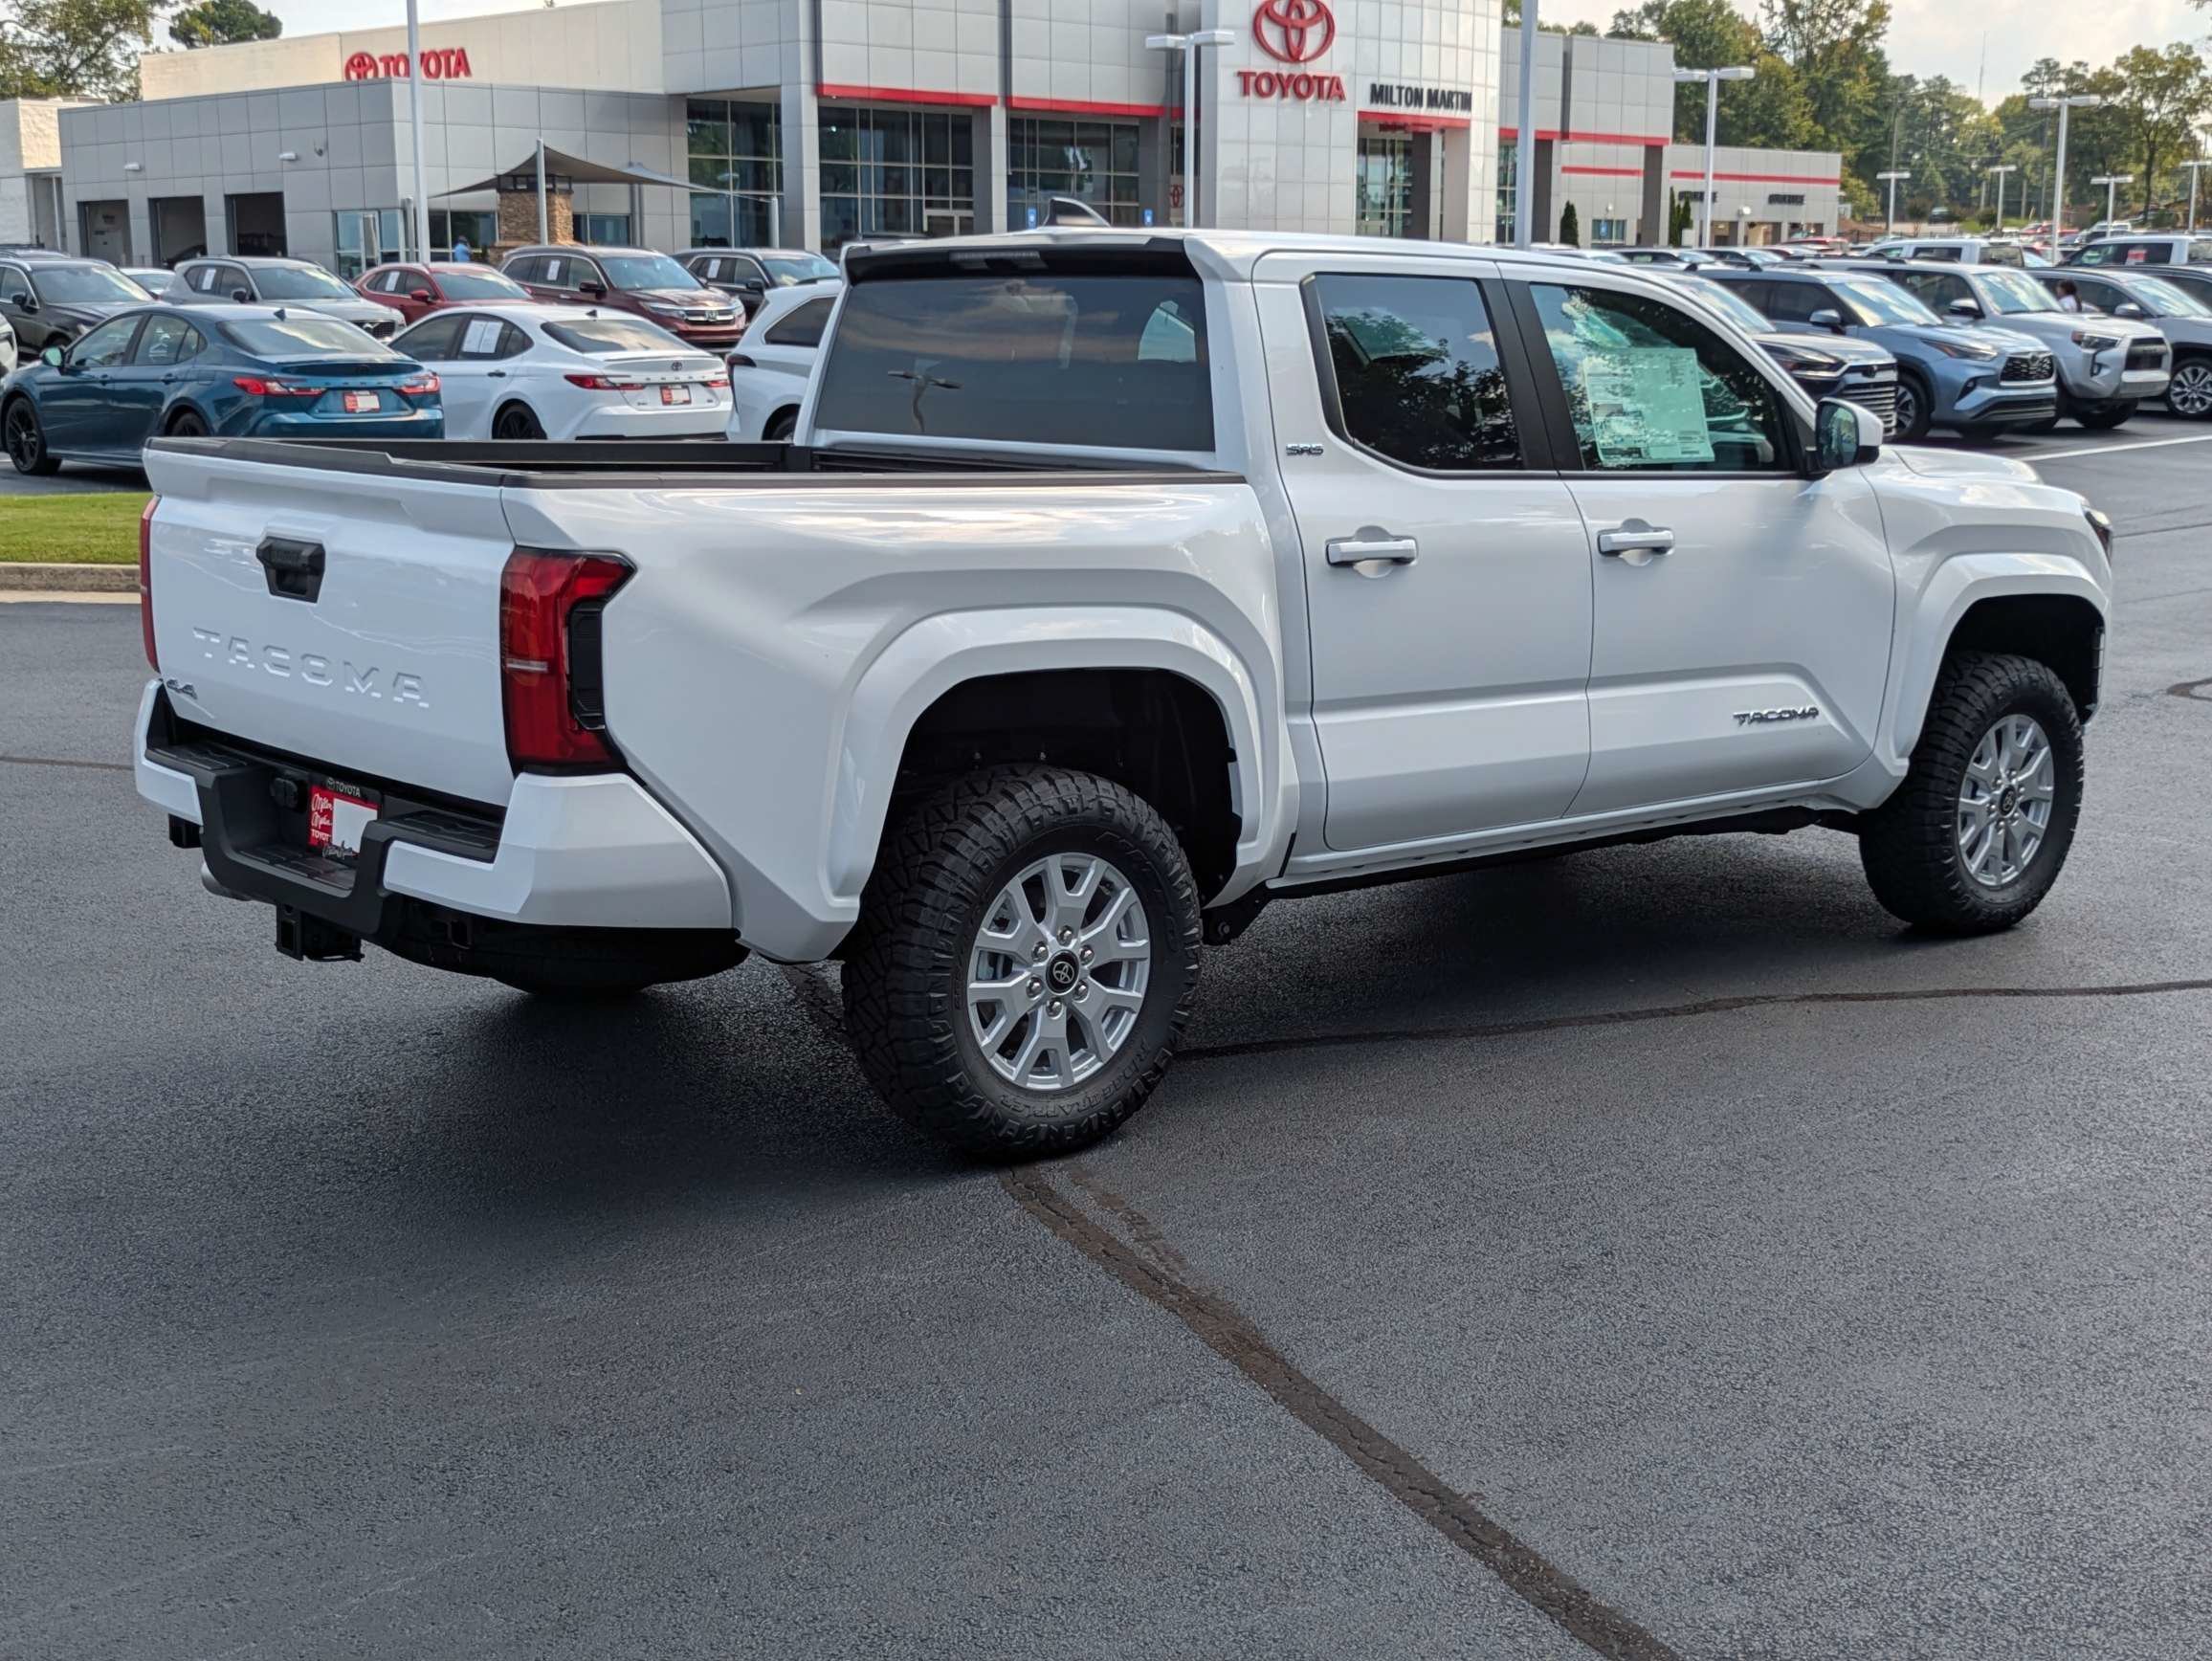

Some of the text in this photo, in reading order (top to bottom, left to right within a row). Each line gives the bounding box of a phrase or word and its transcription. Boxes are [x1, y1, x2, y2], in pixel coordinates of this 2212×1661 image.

[1238, 71, 1346, 101] TOYOTA
[1370, 83, 1471, 112] MILTON MARTIN
[193, 627, 429, 707] TACOMA
[1733, 706, 1819, 725] TACOMA
[336, 781, 361, 797] TOYOTA
